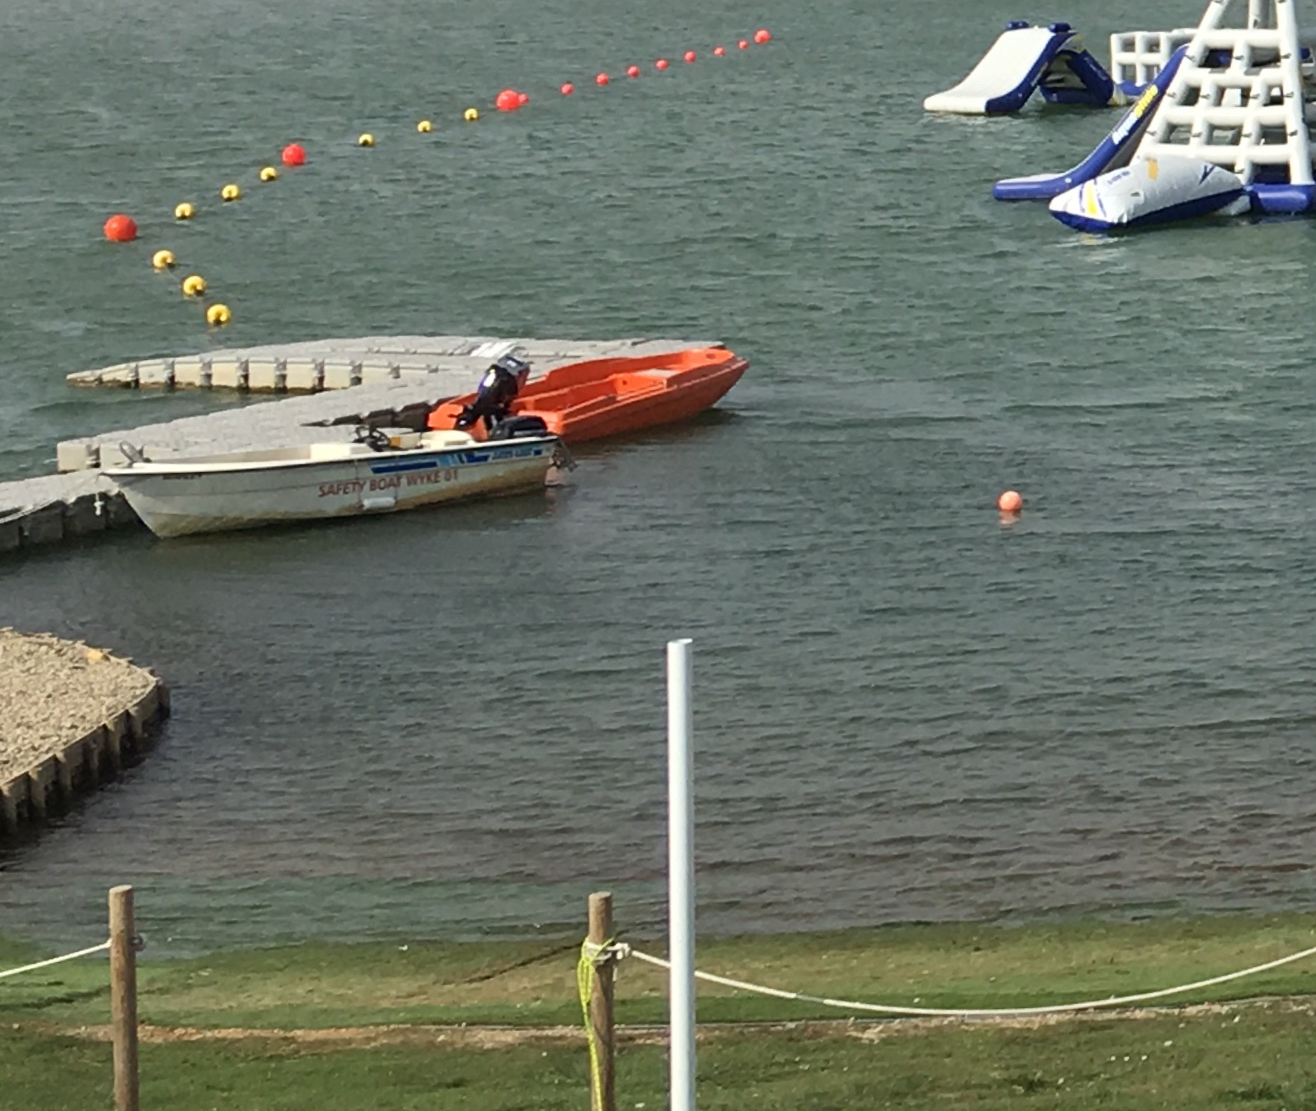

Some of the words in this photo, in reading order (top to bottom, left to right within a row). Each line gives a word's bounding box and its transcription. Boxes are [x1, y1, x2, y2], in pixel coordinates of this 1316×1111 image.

[318, 480, 367, 498] SAFETY
[369, 474, 402, 492] BOAT
[405, 469, 441, 488] WYKE
